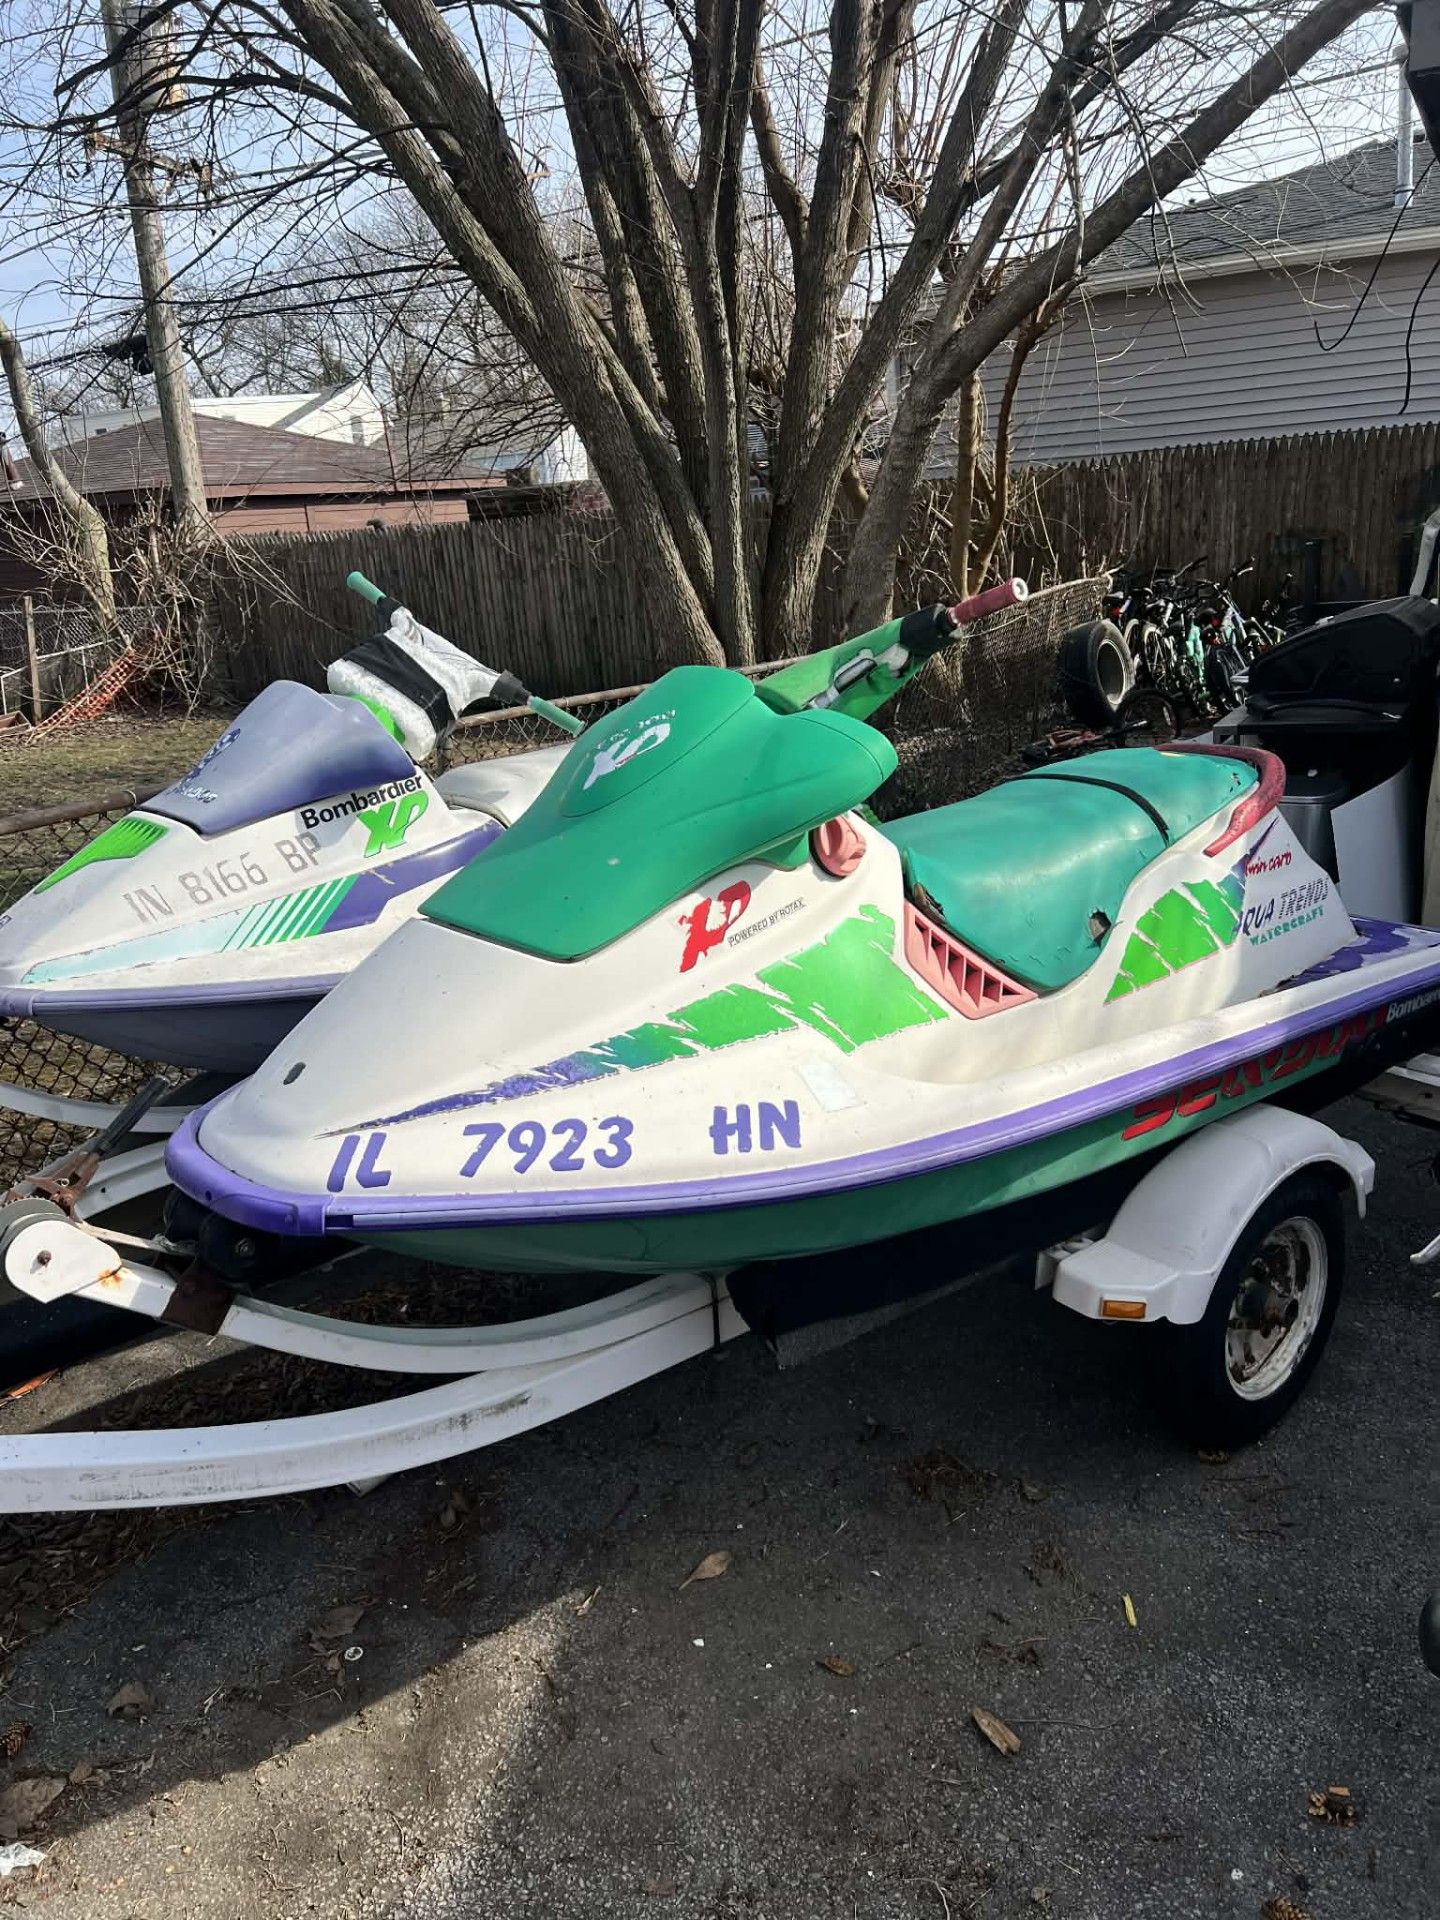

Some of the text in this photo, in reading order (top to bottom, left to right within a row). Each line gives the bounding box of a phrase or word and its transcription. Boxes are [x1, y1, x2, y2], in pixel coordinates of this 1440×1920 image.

[300, 775, 423, 830] Bombardier
[356, 790, 430, 859] XP
[122, 884, 175, 924] IN
[178, 851, 269, 905] 8166
[727, 897, 807, 948] POWERED BY ROTAX
[326, 1099, 802, 1193] IL 7923 HN
